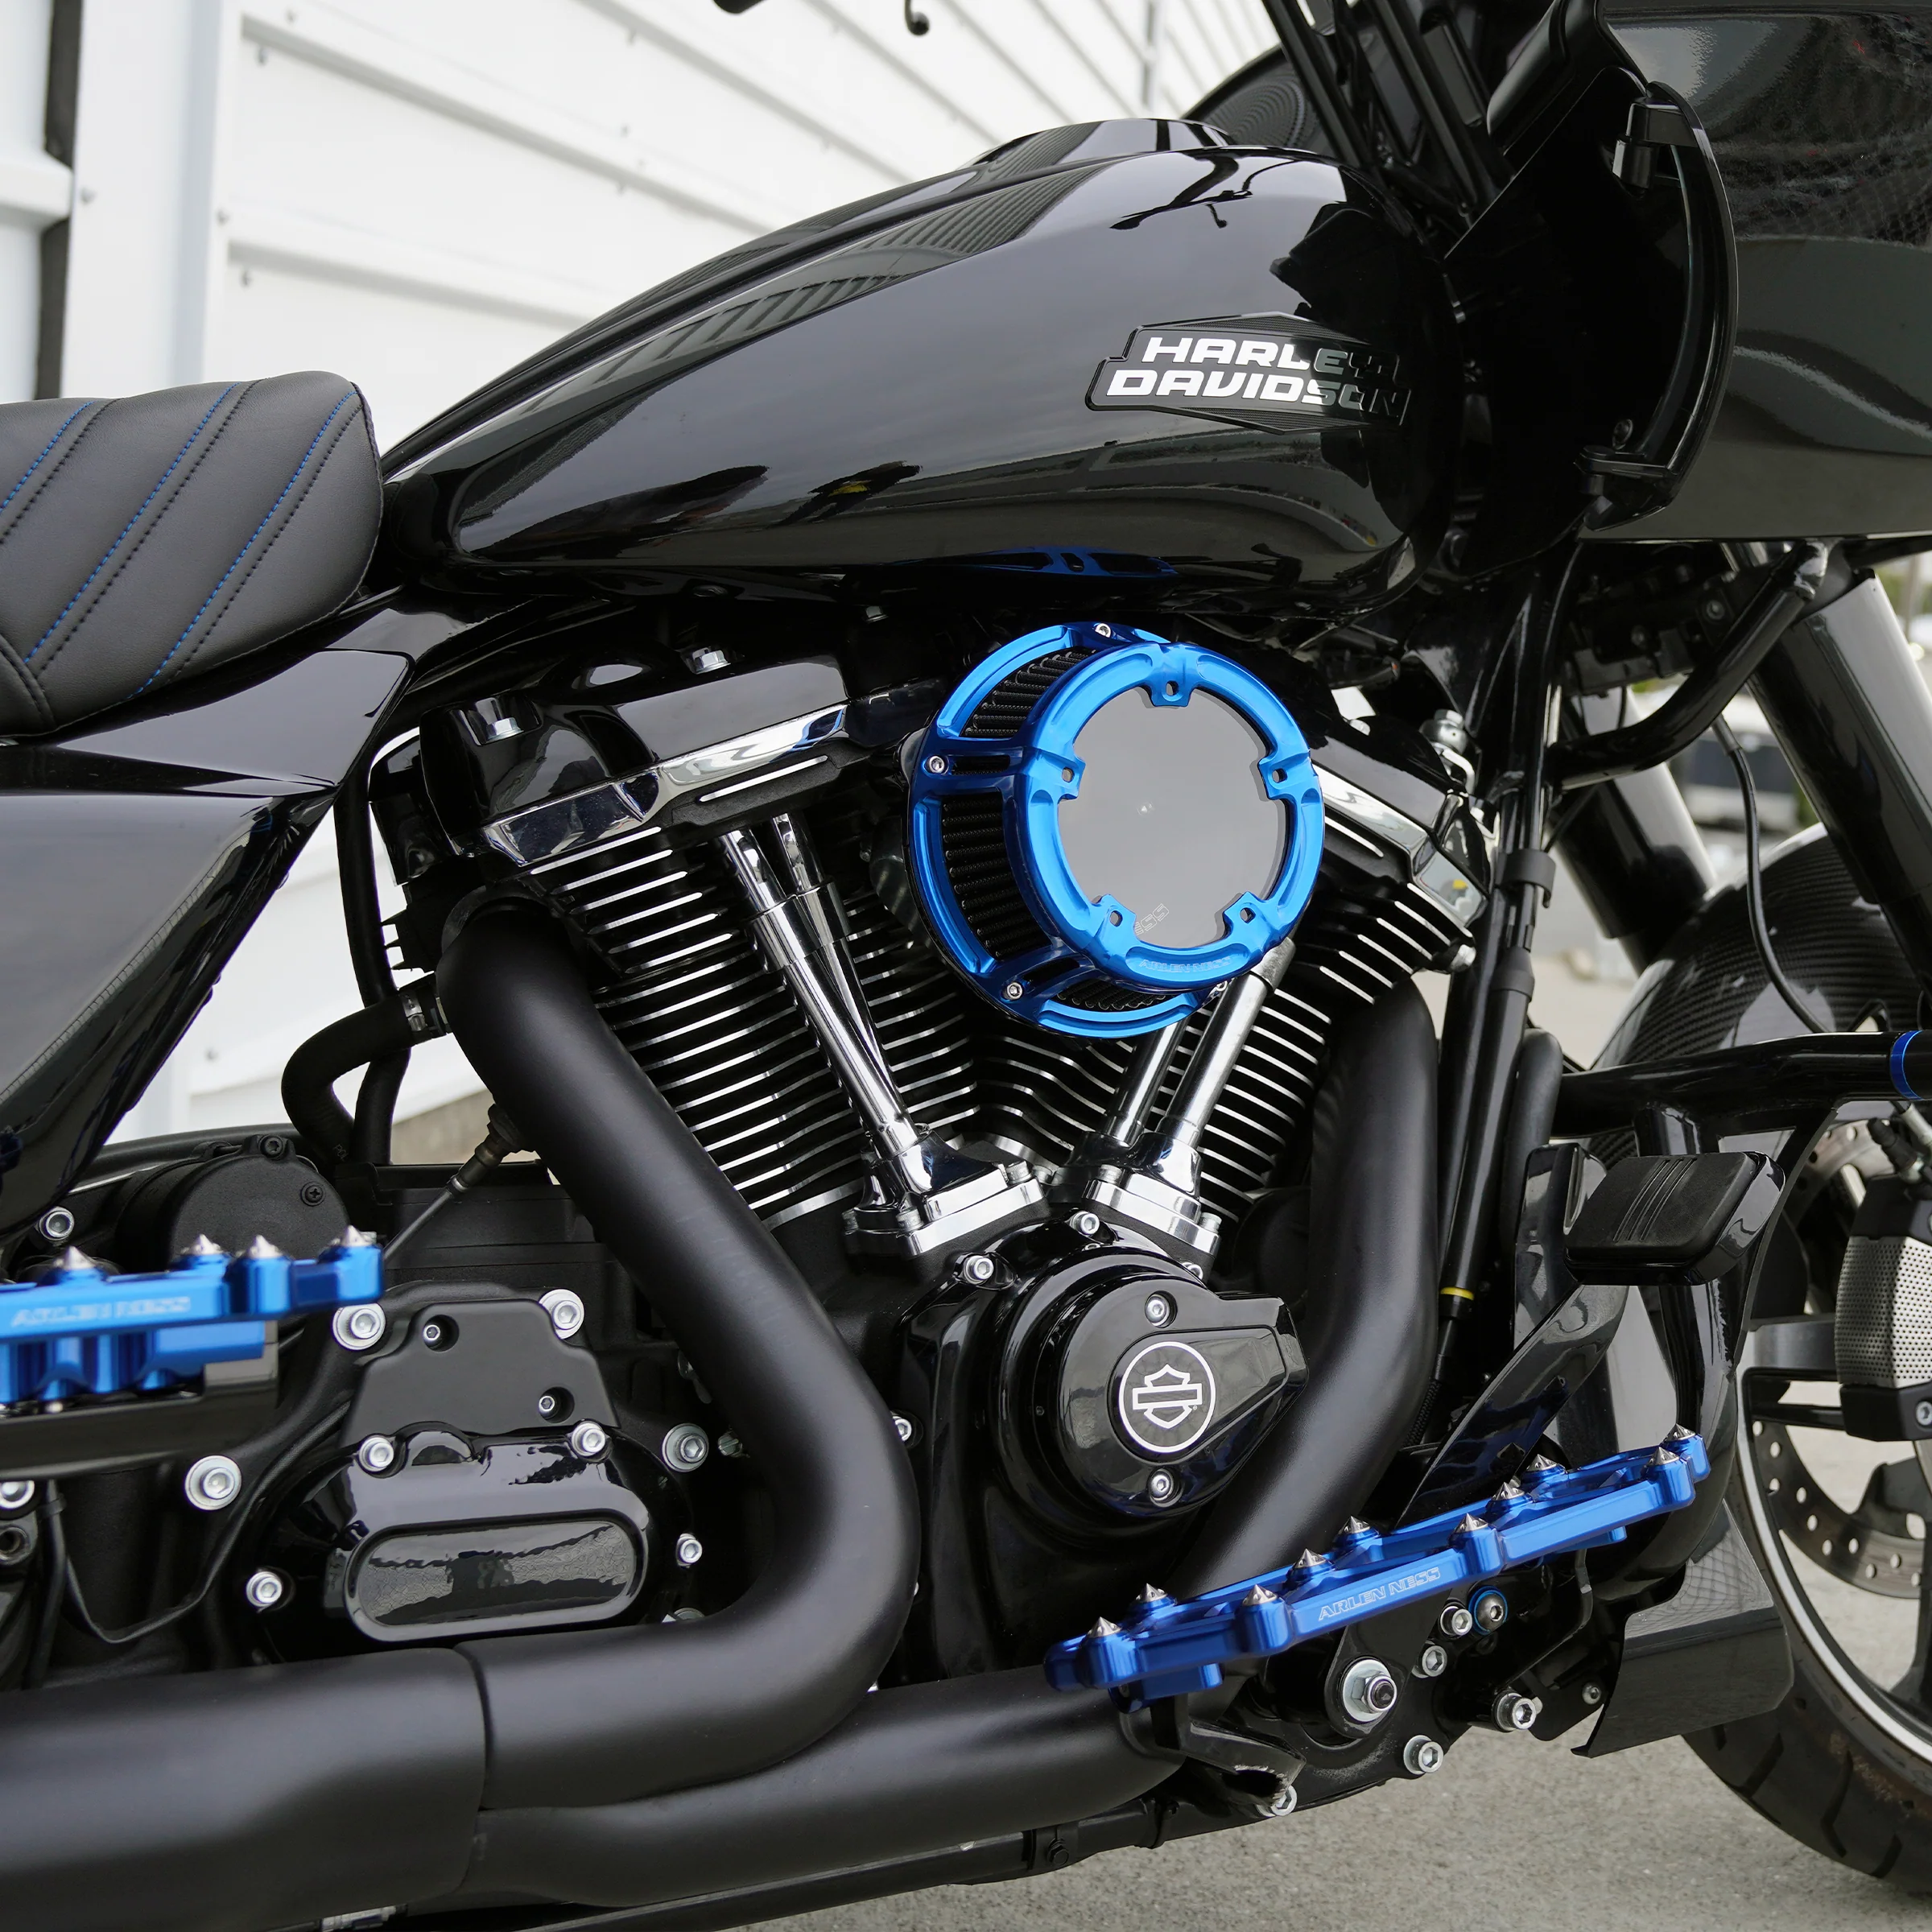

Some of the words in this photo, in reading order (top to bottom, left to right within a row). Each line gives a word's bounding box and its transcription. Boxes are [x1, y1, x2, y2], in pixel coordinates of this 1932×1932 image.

[1106, 369, 1402, 418] DAVIDSON
[1140, 959, 1191, 973] ARLEN
[1318, 1585, 1387, 1621] ARLEN
[1389, 1567, 1441, 1596] NESS
